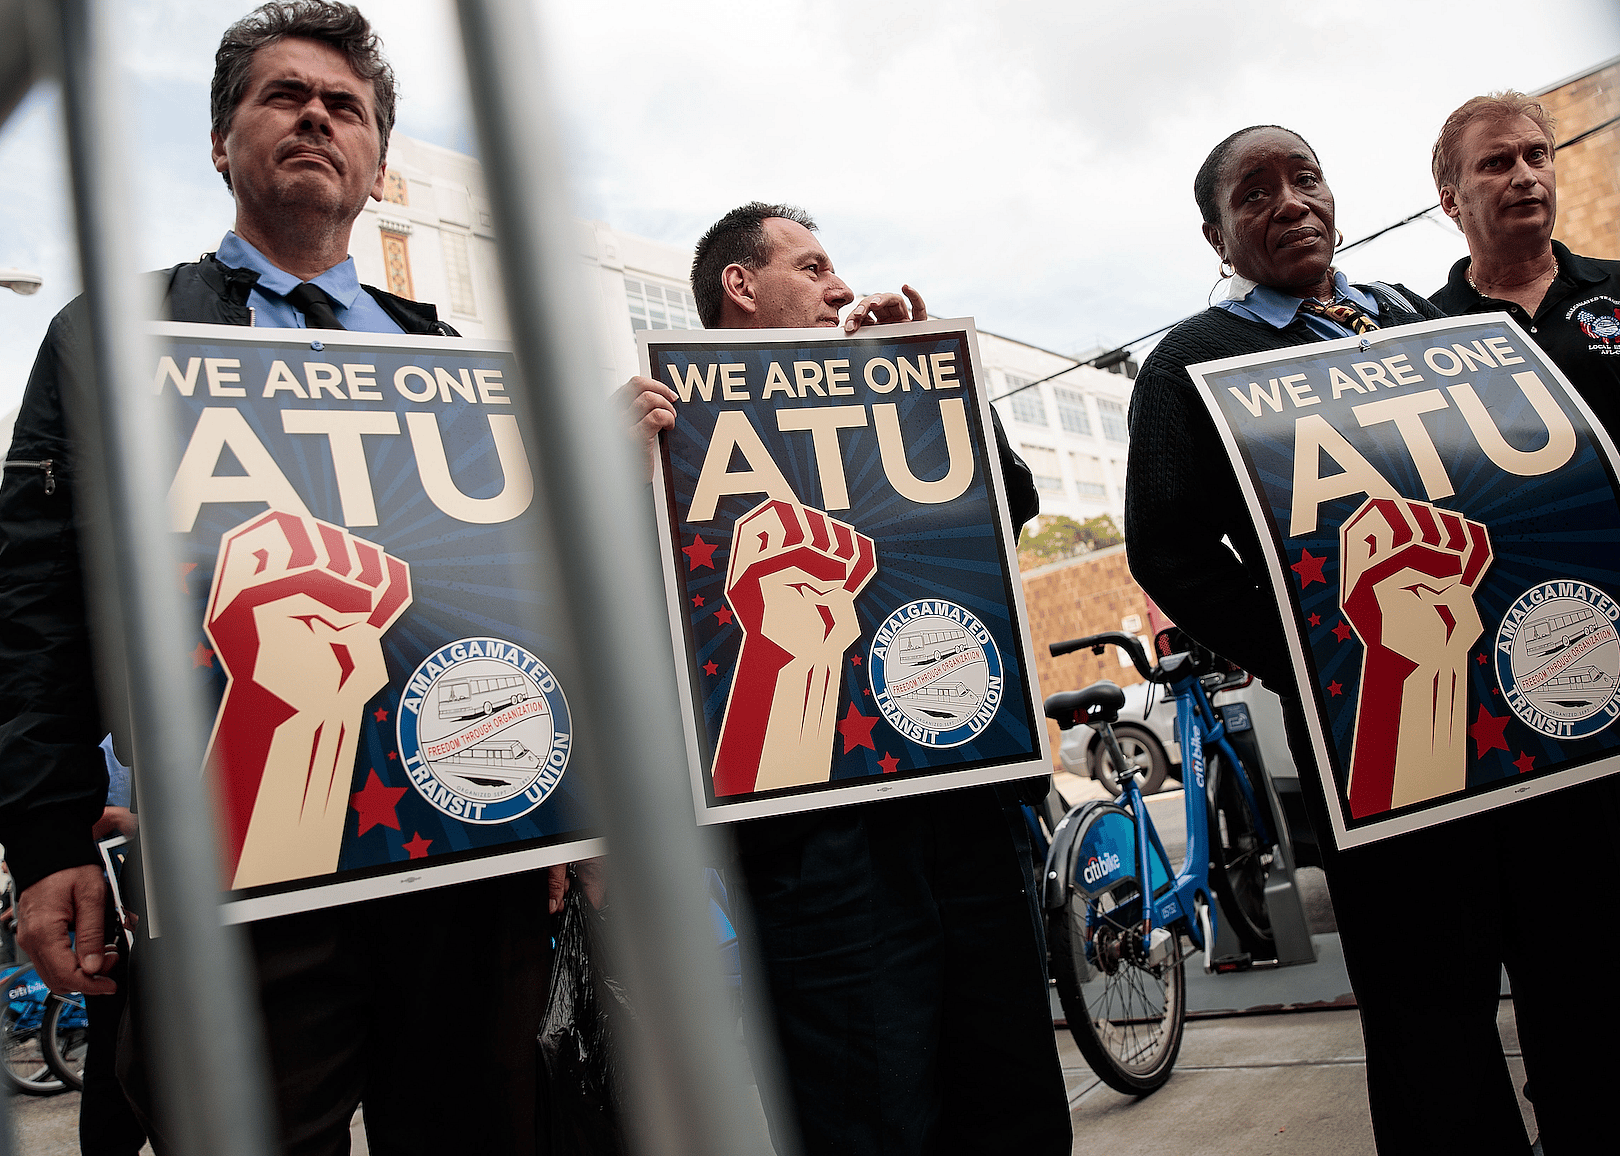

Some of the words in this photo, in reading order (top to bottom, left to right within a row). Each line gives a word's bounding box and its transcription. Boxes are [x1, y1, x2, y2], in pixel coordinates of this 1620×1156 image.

[262, 360, 383, 401] ARE
[393, 366, 511, 404] ONE
[666, 363, 750, 403] WE
[762, 359, 854, 399] ARE
[863, 352, 960, 394] ONE
[1228, 373, 1322, 417] WE
[1329, 354, 1425, 399] ARE
[1424, 336, 1526, 377] ONE
[165, 406, 535, 533] ATU
[686, 397, 975, 523] ATU
[1289, 370, 1577, 537] ATU
[873, 602, 990, 661] AMALGAMATED
[1498, 582, 1620, 656] AMALGAMATED
[403, 641, 556, 715] AMALGAMATED
[892, 678, 917, 694] FREEDOM
[917, 665, 942, 686] THROUGH
[941, 650, 980, 672] ORGANIZATION
[1522, 669, 1548, 689] FREEDOM
[1547, 654, 1572, 675] THROUGH
[1571, 629, 1612, 658] ORGANIZATION
[427, 737, 461, 758] FREEDOM
[461, 722, 493, 746] THROUGH
[493, 701, 543, 728] ORGANIZATION
[876, 688, 940, 745] TRANSIT
[967, 676, 1001, 734] UNION
[1506, 684, 1575, 736] TRANSIT
[406, 750, 487, 820] TRANSIT
[456, 786, 491, 797] ORGANIZED
[524, 731, 570, 804] UNION
